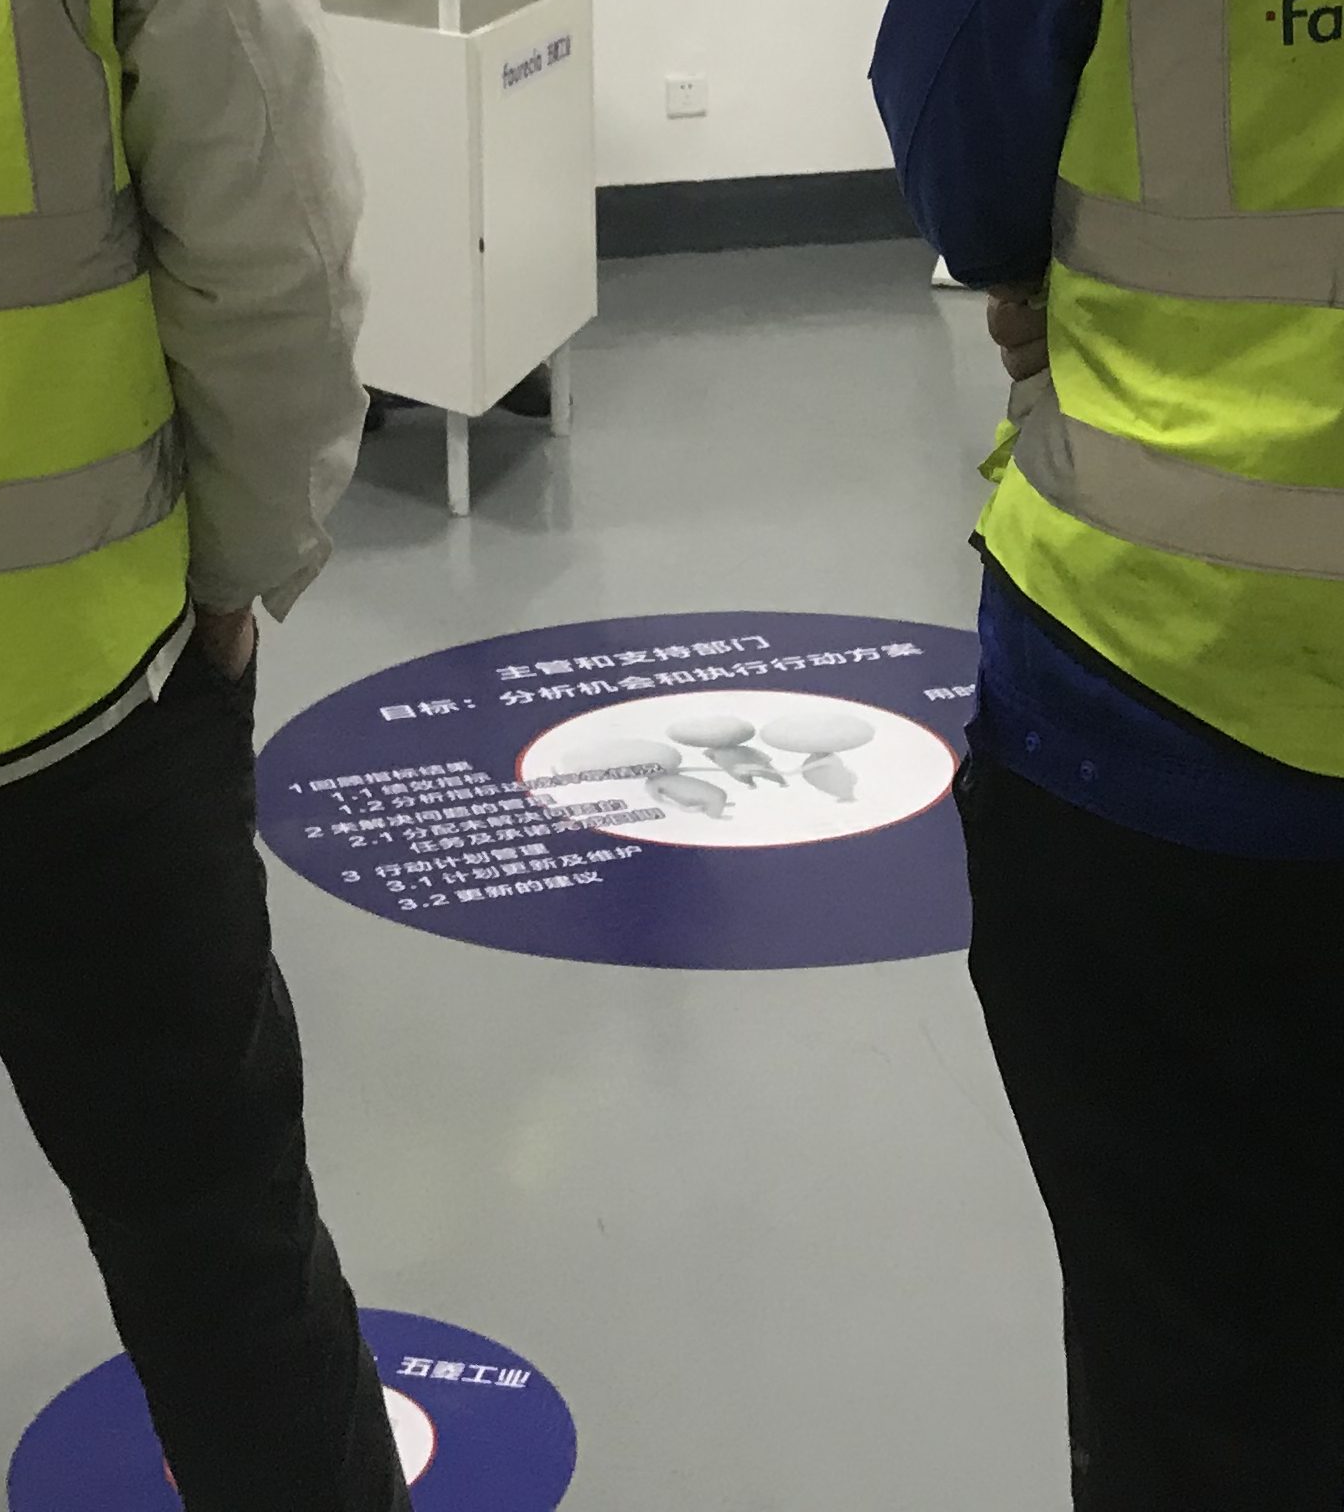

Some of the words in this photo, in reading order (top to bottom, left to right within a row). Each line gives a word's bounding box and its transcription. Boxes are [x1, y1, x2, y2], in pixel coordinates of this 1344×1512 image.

[496, 634, 770, 682] 主管和支持部门
[499, 642, 925, 706] 分析机会和执行行动方案
[289, 782, 303, 794] 1
[332, 787, 373, 802] 1.1
[339, 798, 385, 815] 1.2
[304, 826, 323, 839] 2
[349, 832, 392, 848] 2.1
[341, 869, 360, 883] 3
[375, 843, 549, 878] 行动计划管理
[386, 876, 432, 893] 3.1
[442, 845, 643, 885] 计划更新及维护
[398, 893, 450, 911] 3.2
[455, 870, 604, 903] 更新的建议
